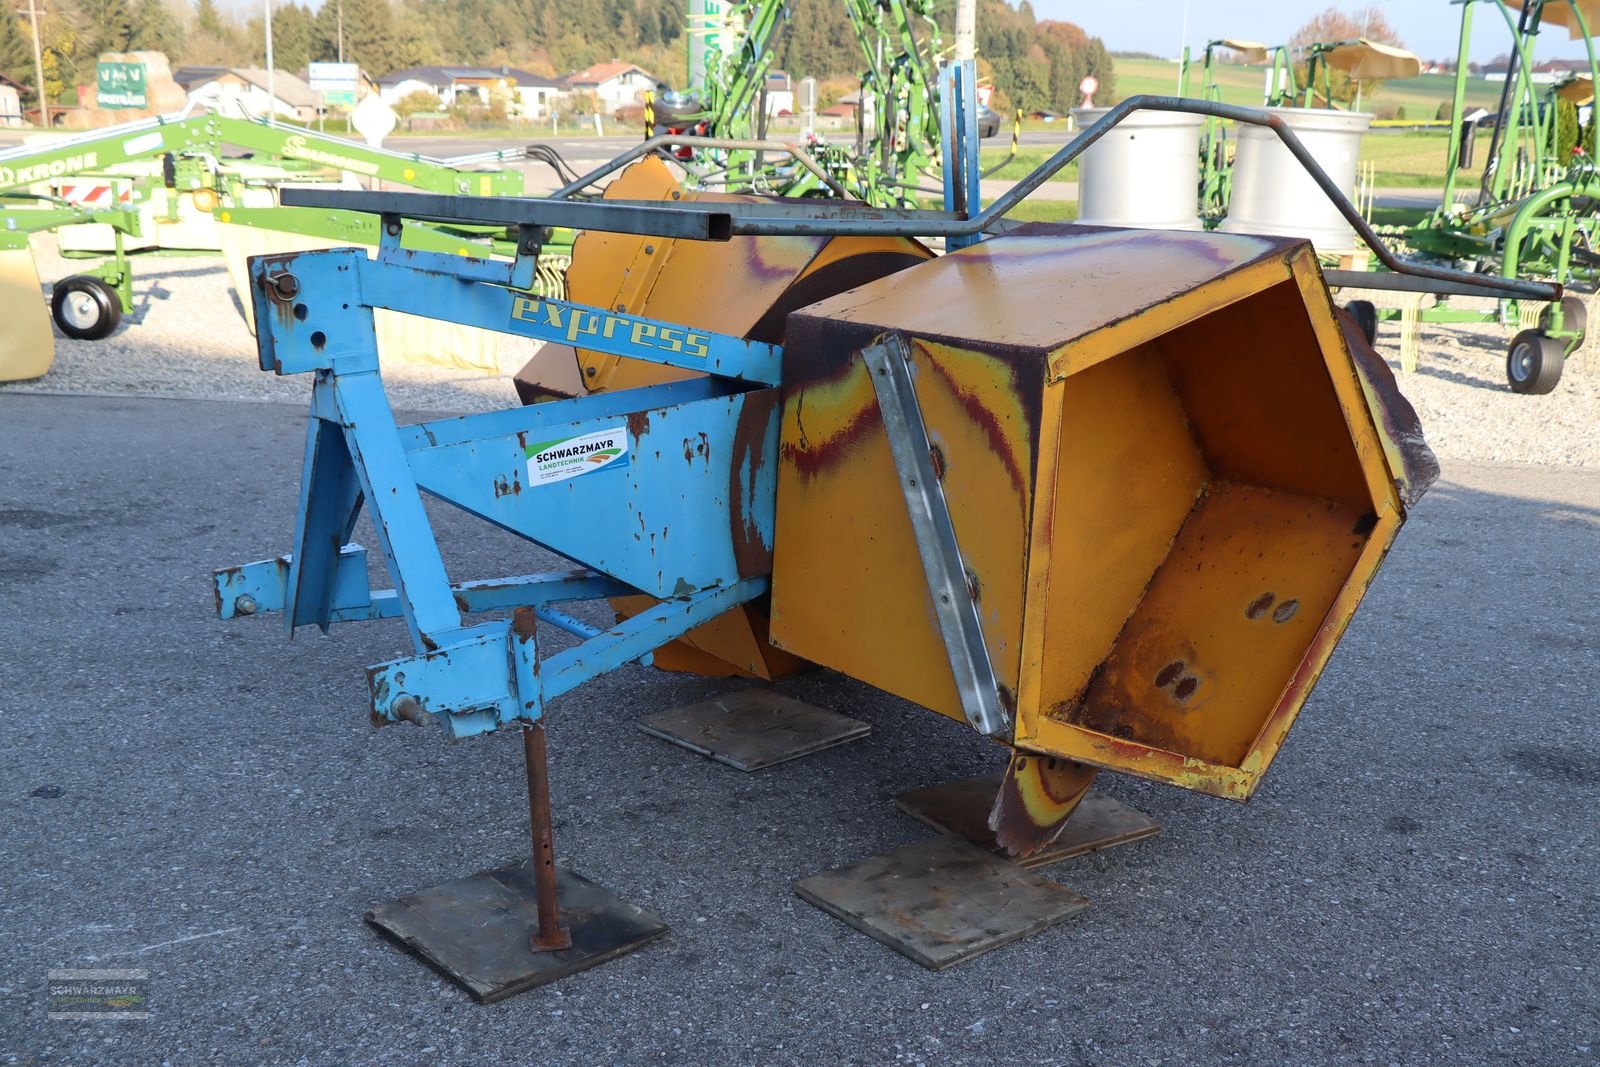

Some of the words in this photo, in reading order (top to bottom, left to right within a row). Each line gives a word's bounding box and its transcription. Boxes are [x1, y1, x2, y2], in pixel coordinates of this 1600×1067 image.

[16, 151, 98, 184] KRONE
[511, 296, 711, 358] express
[536, 439, 614, 464] SCHWARZMAYR
[539, 456, 585, 471] LANDTECHNIK
